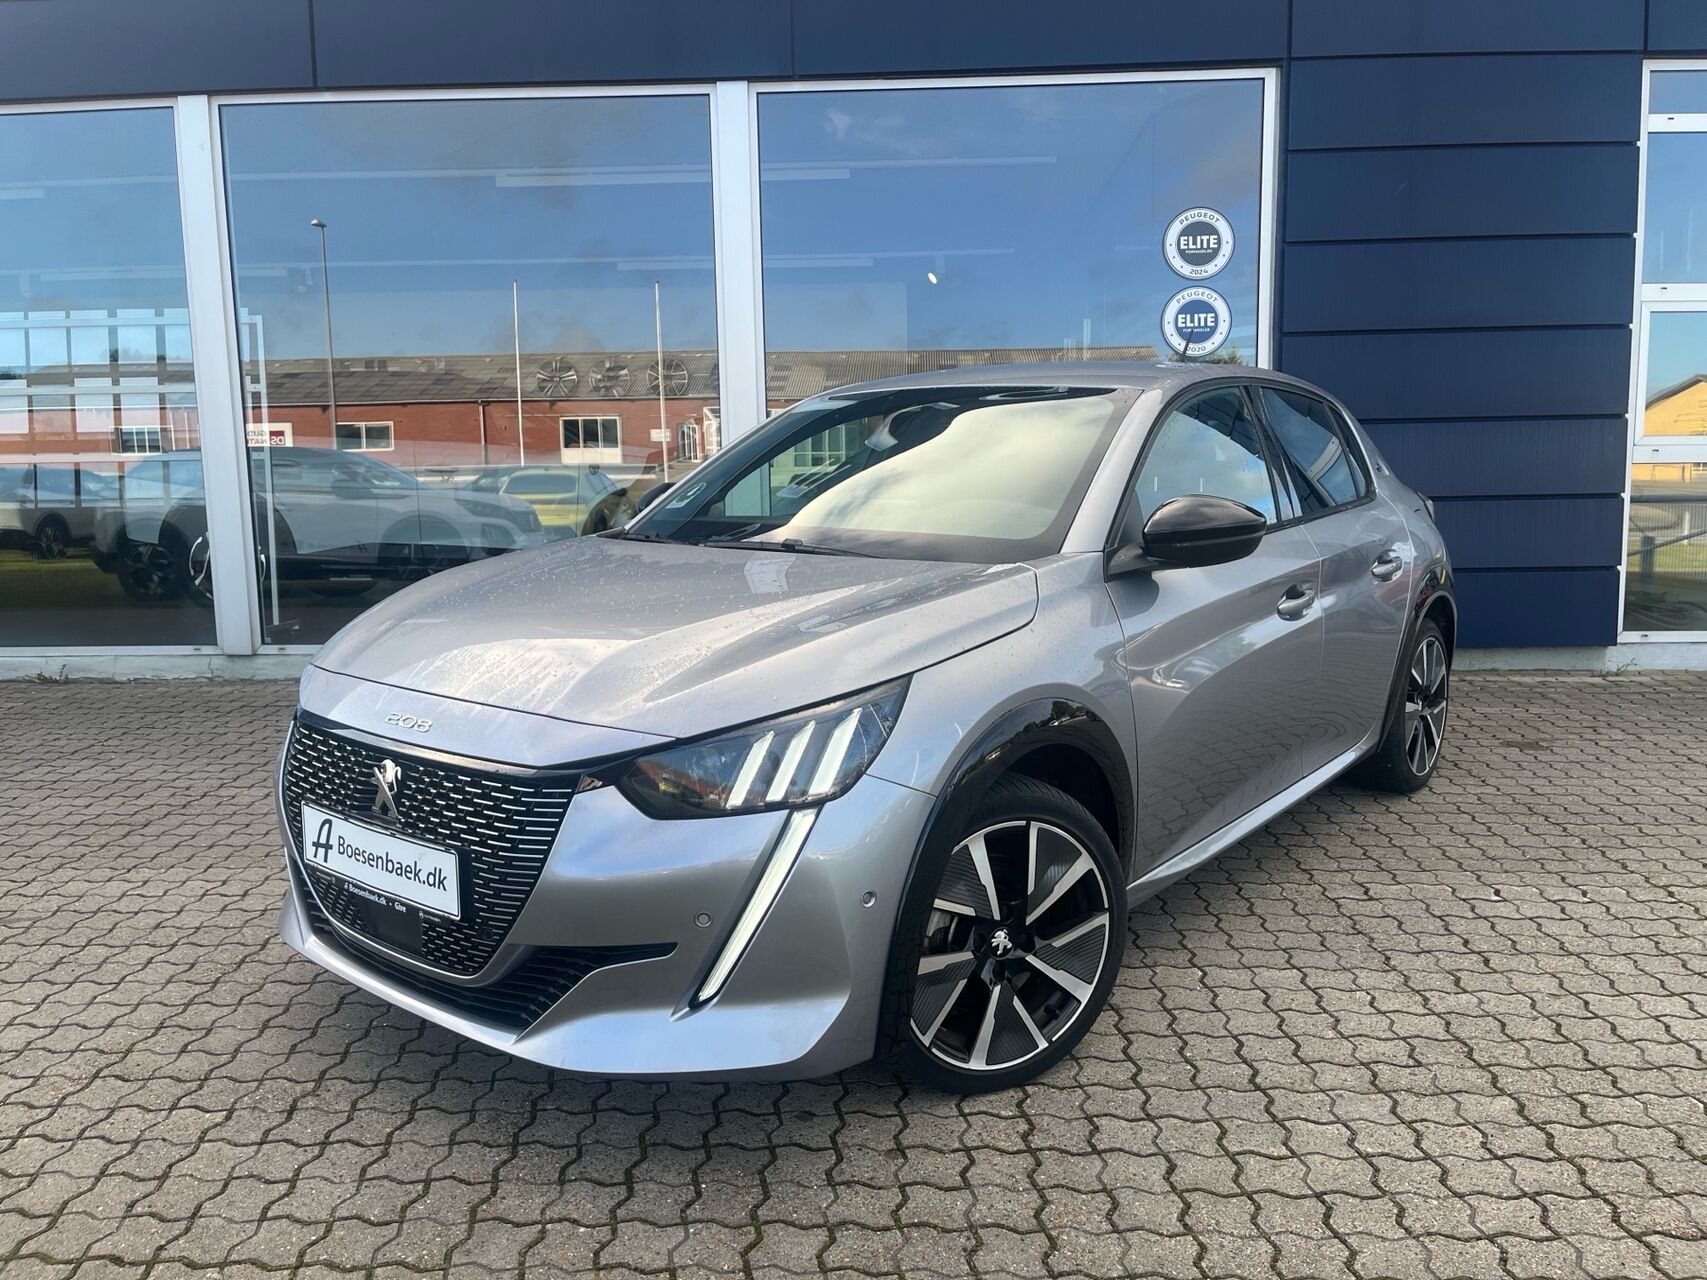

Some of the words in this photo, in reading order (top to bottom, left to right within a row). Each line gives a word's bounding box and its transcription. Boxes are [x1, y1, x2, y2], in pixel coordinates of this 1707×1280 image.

[1178, 211, 1220, 226] PEUGEOT
[1179, 235, 1218, 249] ELITE
[1176, 290, 1218, 305] PEUGEOT
[1177, 313, 1215, 327] ELITE
[384, 712, 434, 734] 208
[336, 835, 448, 892] Boesenbaek.dk
